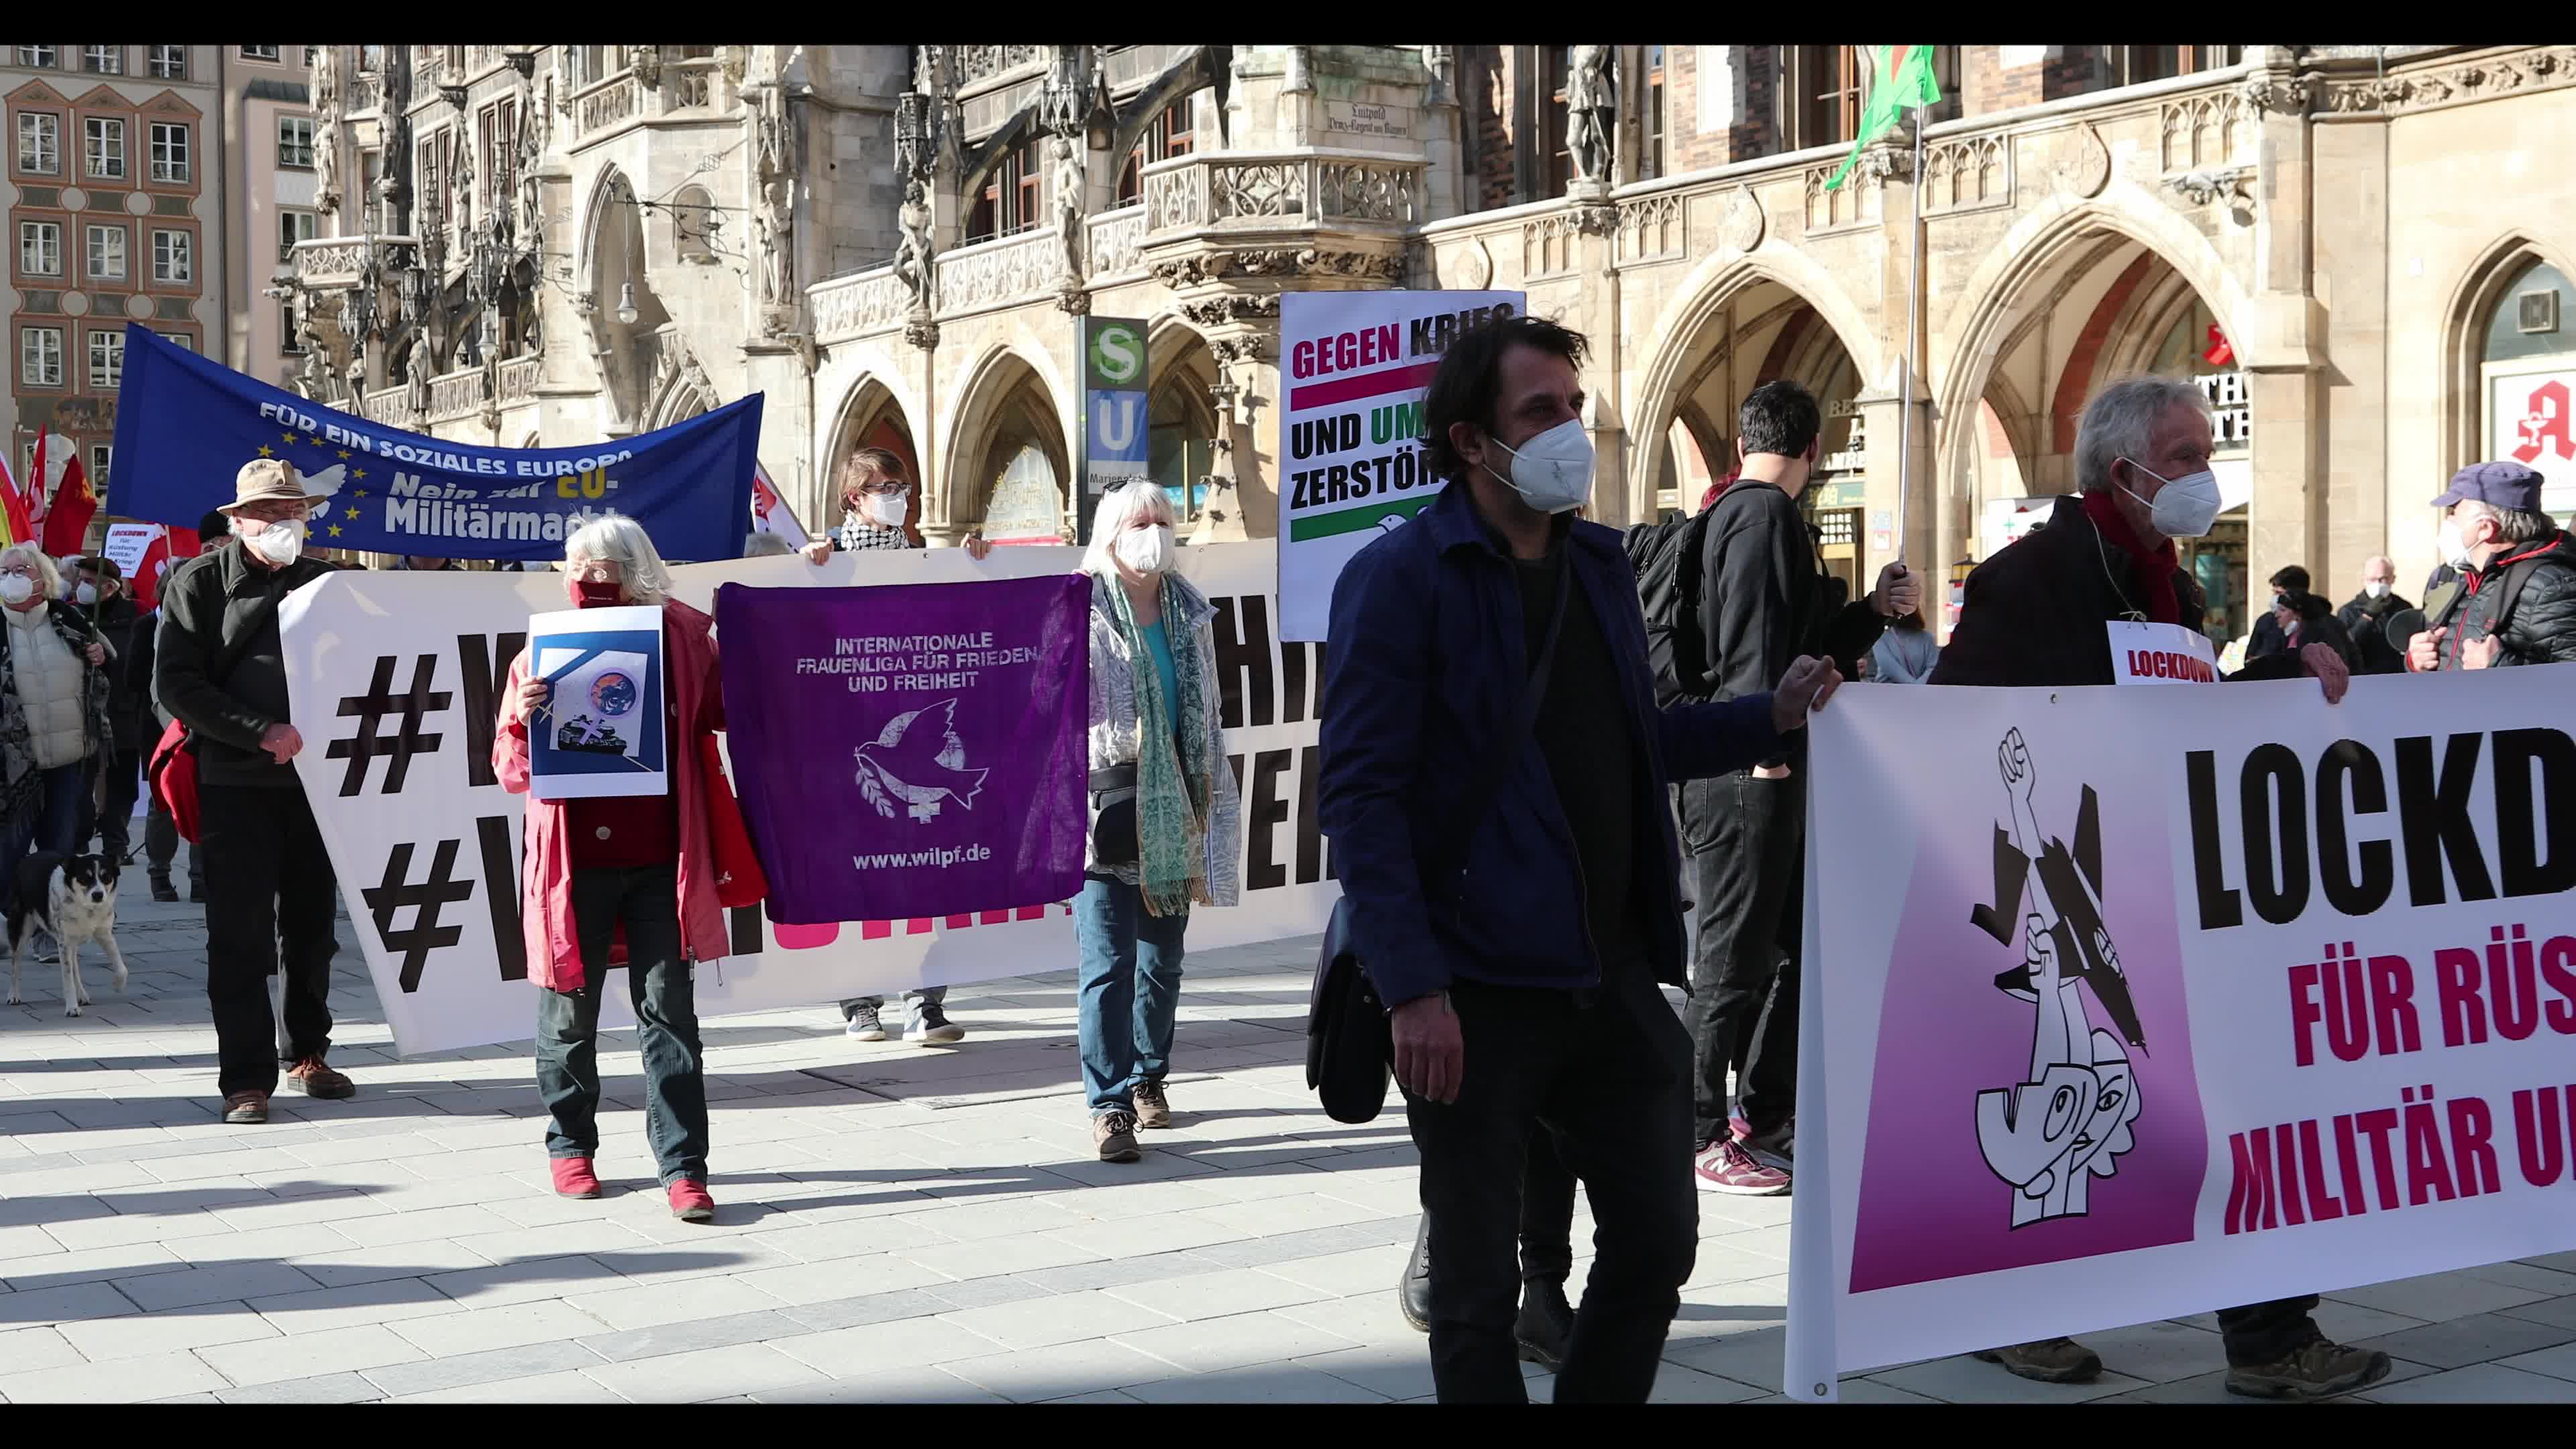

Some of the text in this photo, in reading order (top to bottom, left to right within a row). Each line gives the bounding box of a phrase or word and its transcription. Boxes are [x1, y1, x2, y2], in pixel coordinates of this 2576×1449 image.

[1099, 327, 1136, 380] S
[1292, 323, 1400, 379] GEGEN
[260, 402, 633, 477] FÜR EIN SOZIALES EUROPA
[1099, 399, 1134, 451] U
[1291, 401, 1425, 460] UND UM
[389, 468, 619, 500] Nein zur EU-
[1291, 445, 1439, 510] ZERSTÖR
[796, 646, 1037, 674] FRAUENLIGA FÜR FRIEDEN
[835, 632, 994, 655] INTERNATIONALE
[849, 672, 979, 692] UND FREIHEIT
[853, 844, 991, 870] www.wilpf.de
[2288, 941, 2422, 1067] FÜR
[2224, 1084, 2502, 1236] MILITÄR
